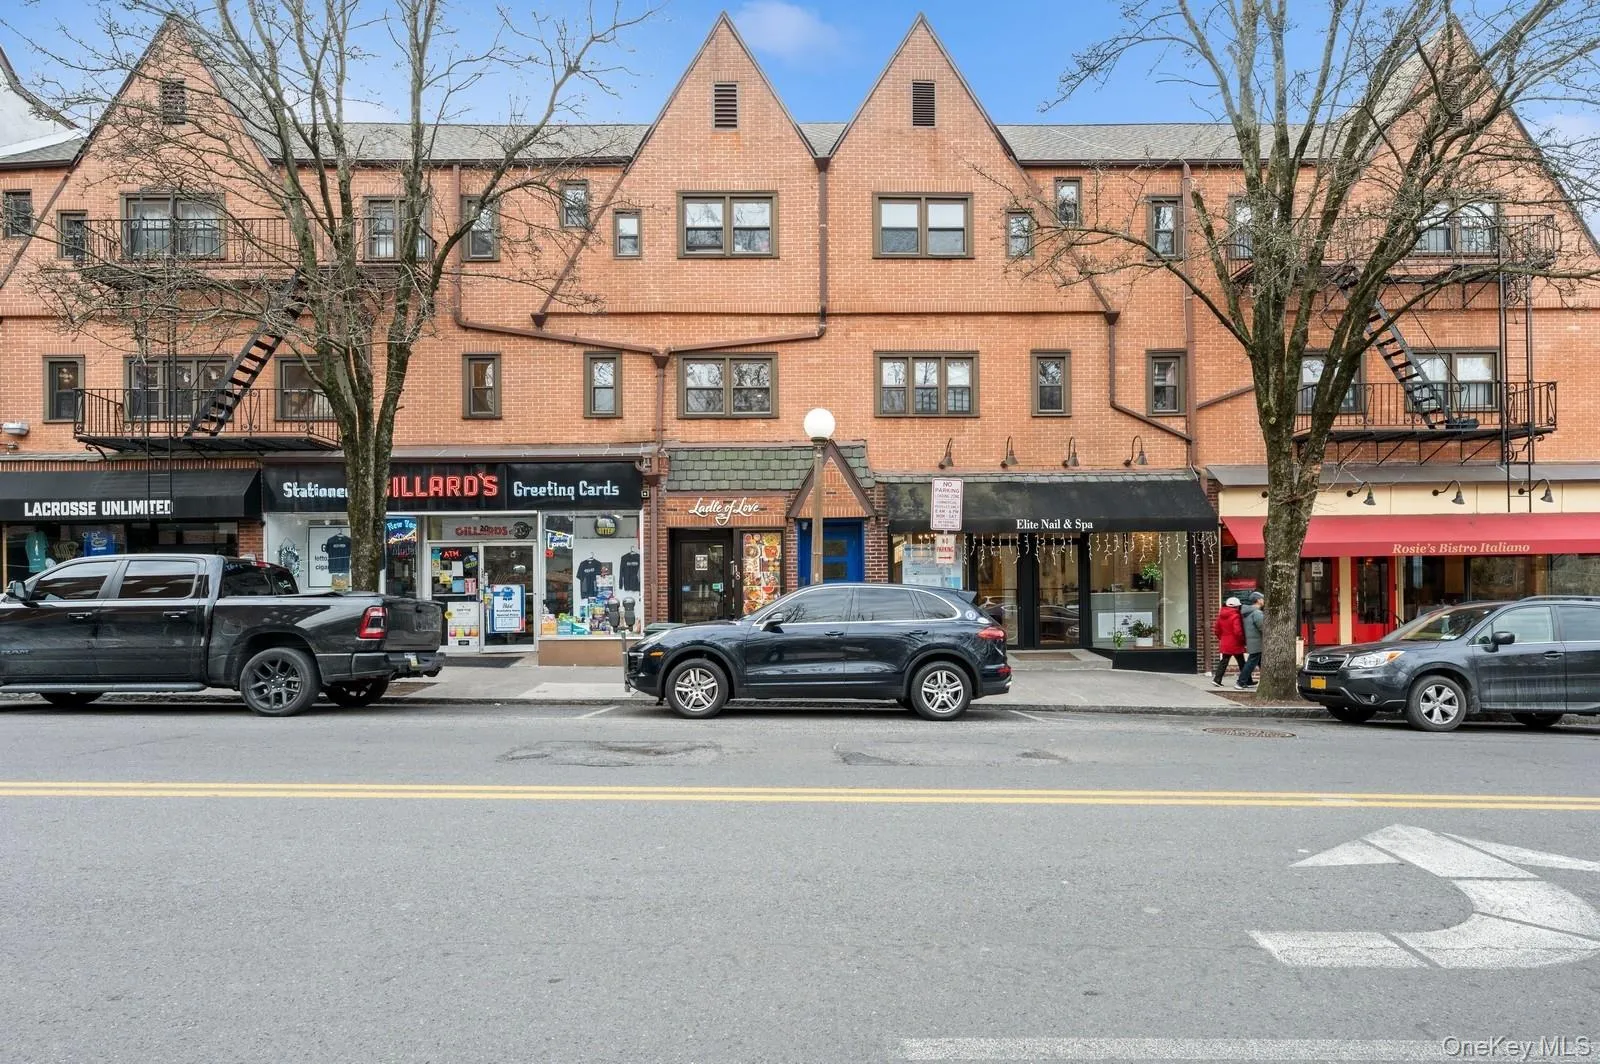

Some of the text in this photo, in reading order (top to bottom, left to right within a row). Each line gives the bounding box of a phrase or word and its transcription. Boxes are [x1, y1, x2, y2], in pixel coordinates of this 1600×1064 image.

[386, 472, 498, 498] ILLARD'S
[513, 480, 620, 501] Greeting Cards
[24, 500, 173, 517] LACROSSE UNLIMITED
[688, 497, 722, 517] Ladle
[733, 497, 760, 517] Love
[1016, 518, 1093, 532] Elite Nail & Spa
[443, 550, 460, 558] ATM
[1392, 542, 1531, 554] Rosie's Bistro Italiano
